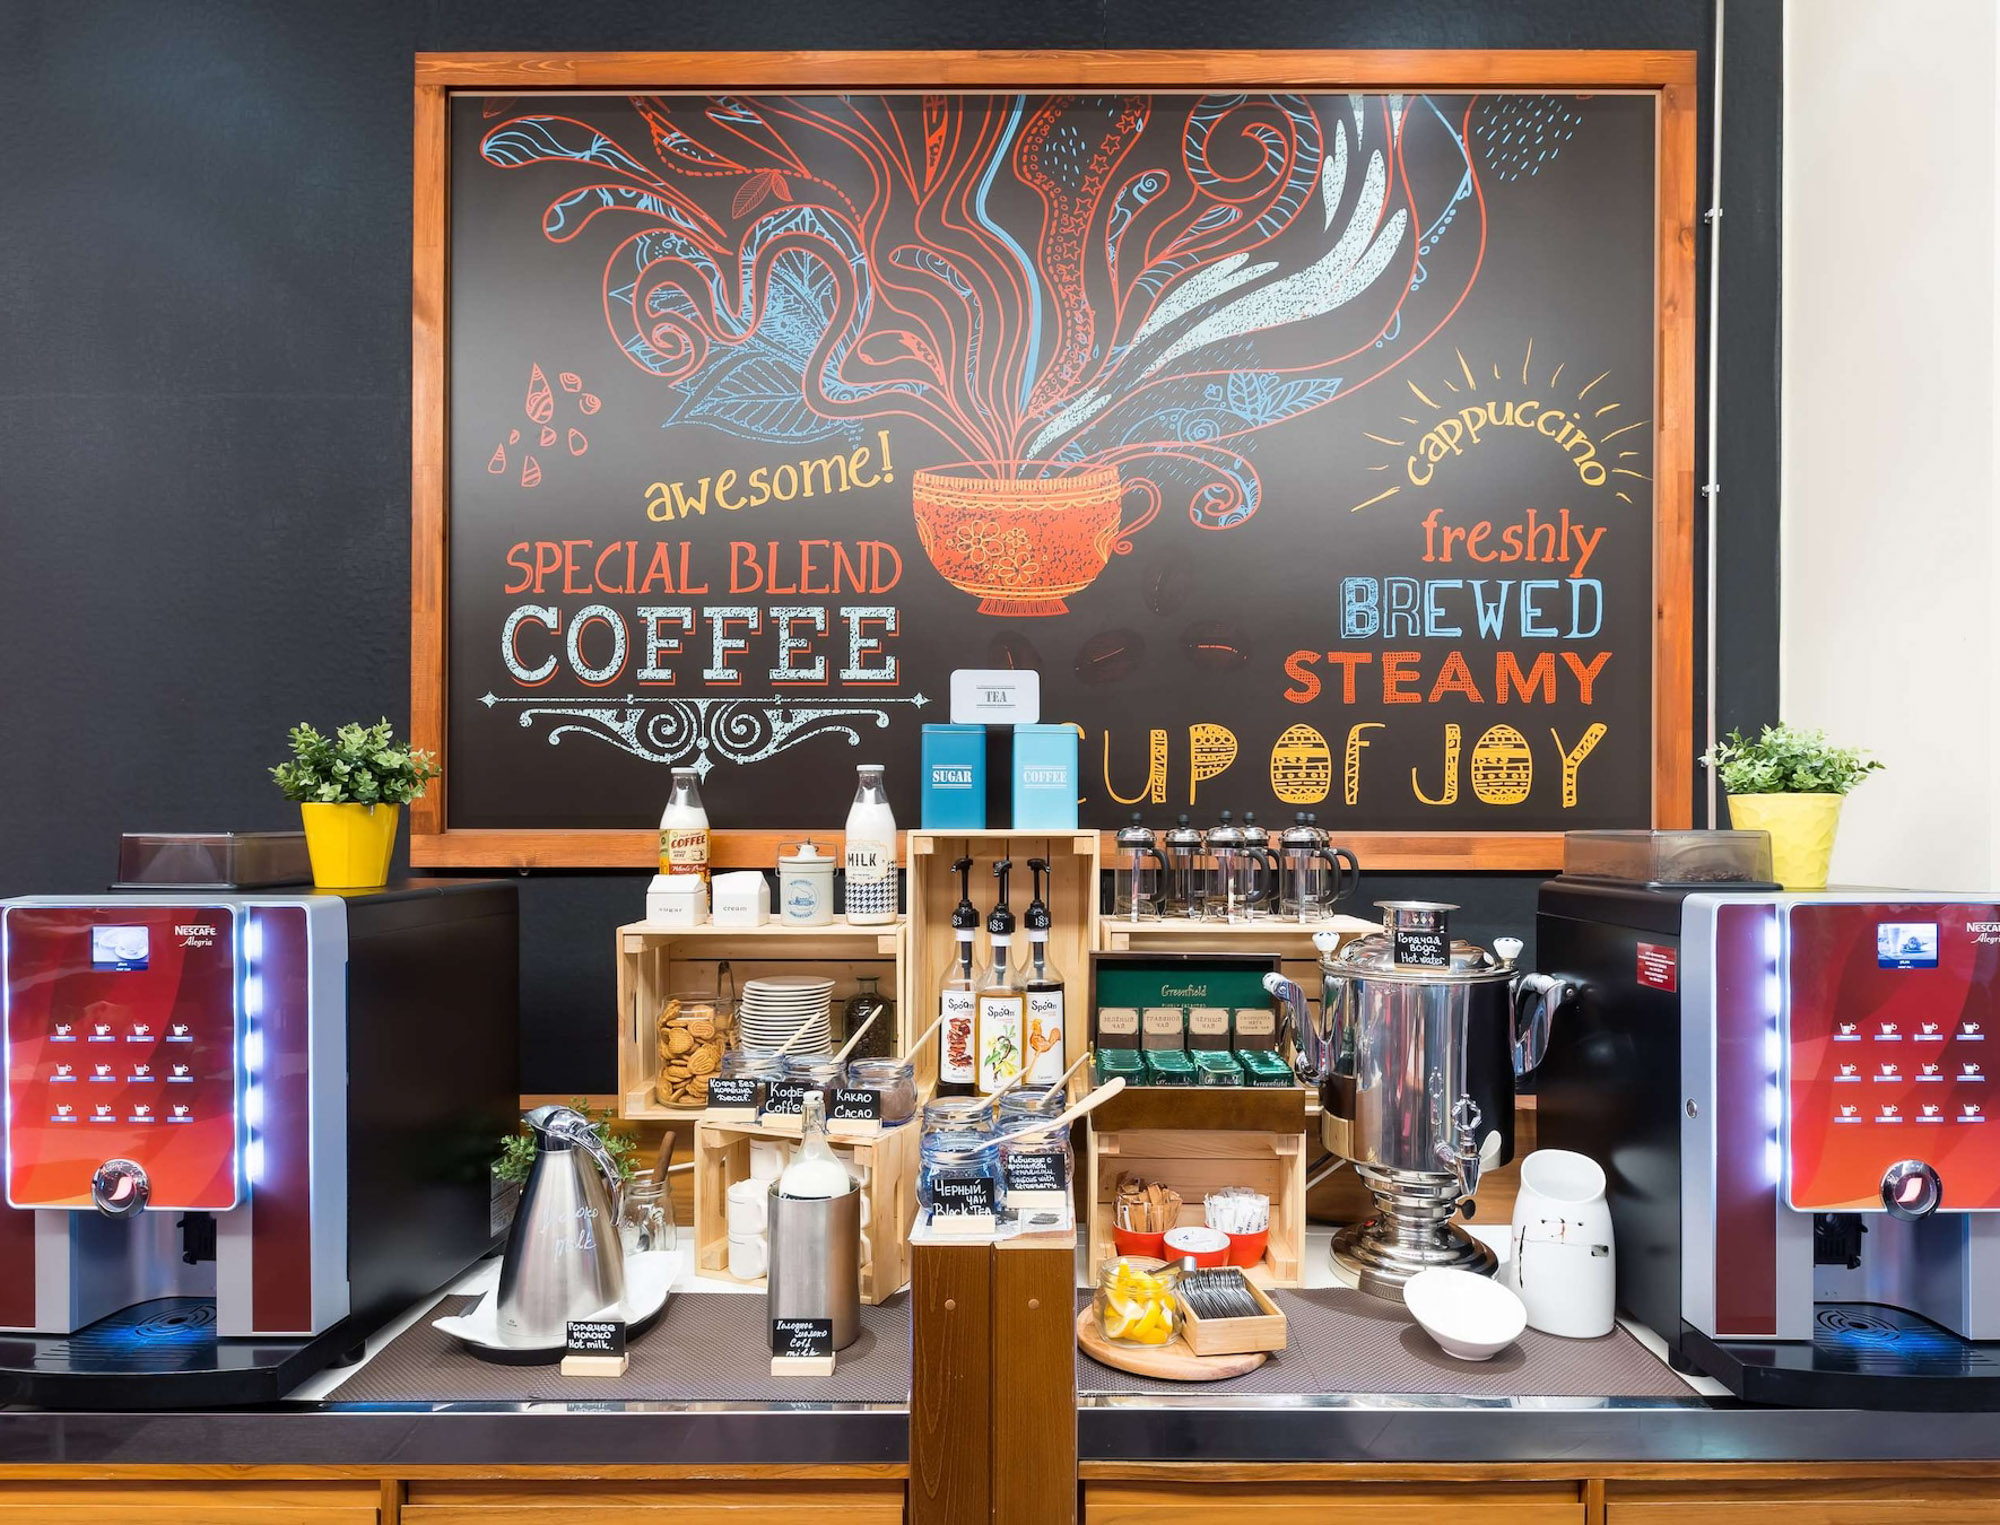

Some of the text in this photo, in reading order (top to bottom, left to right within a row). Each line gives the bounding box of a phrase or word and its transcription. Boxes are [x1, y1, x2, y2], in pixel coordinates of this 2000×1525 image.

[1407, 400, 1607, 486] cappuccino
[645, 430, 894, 522] awesome!
[1421, 508, 1607, 578] freshly
[504, 540, 902, 594] SPECIAL BLEND
[1339, 576, 1603, 640] BREWED
[501, 604, 900, 687] COFFEE
[1283, 650, 1612, 704] STEAMY
[985, 690, 1007, 703] TEA
[1061, 722, 1608, 808] UP OF JOY
[932, 769, 972, 782] SUGAR
[1023, 769, 1067, 783] COFFEE
[671, 835, 706, 849] COFFEE
[847, 853, 877, 866] MILK
[178, 935, 213, 948] Alegria
[1398, 932, 1443, 945] Горячая
[1401, 952, 1418, 963] Hot
[1161, 985, 1208, 997] Greenfield
[568, 1322, 616, 1332] Горячее
[568, 1339, 585, 1349] Hot
